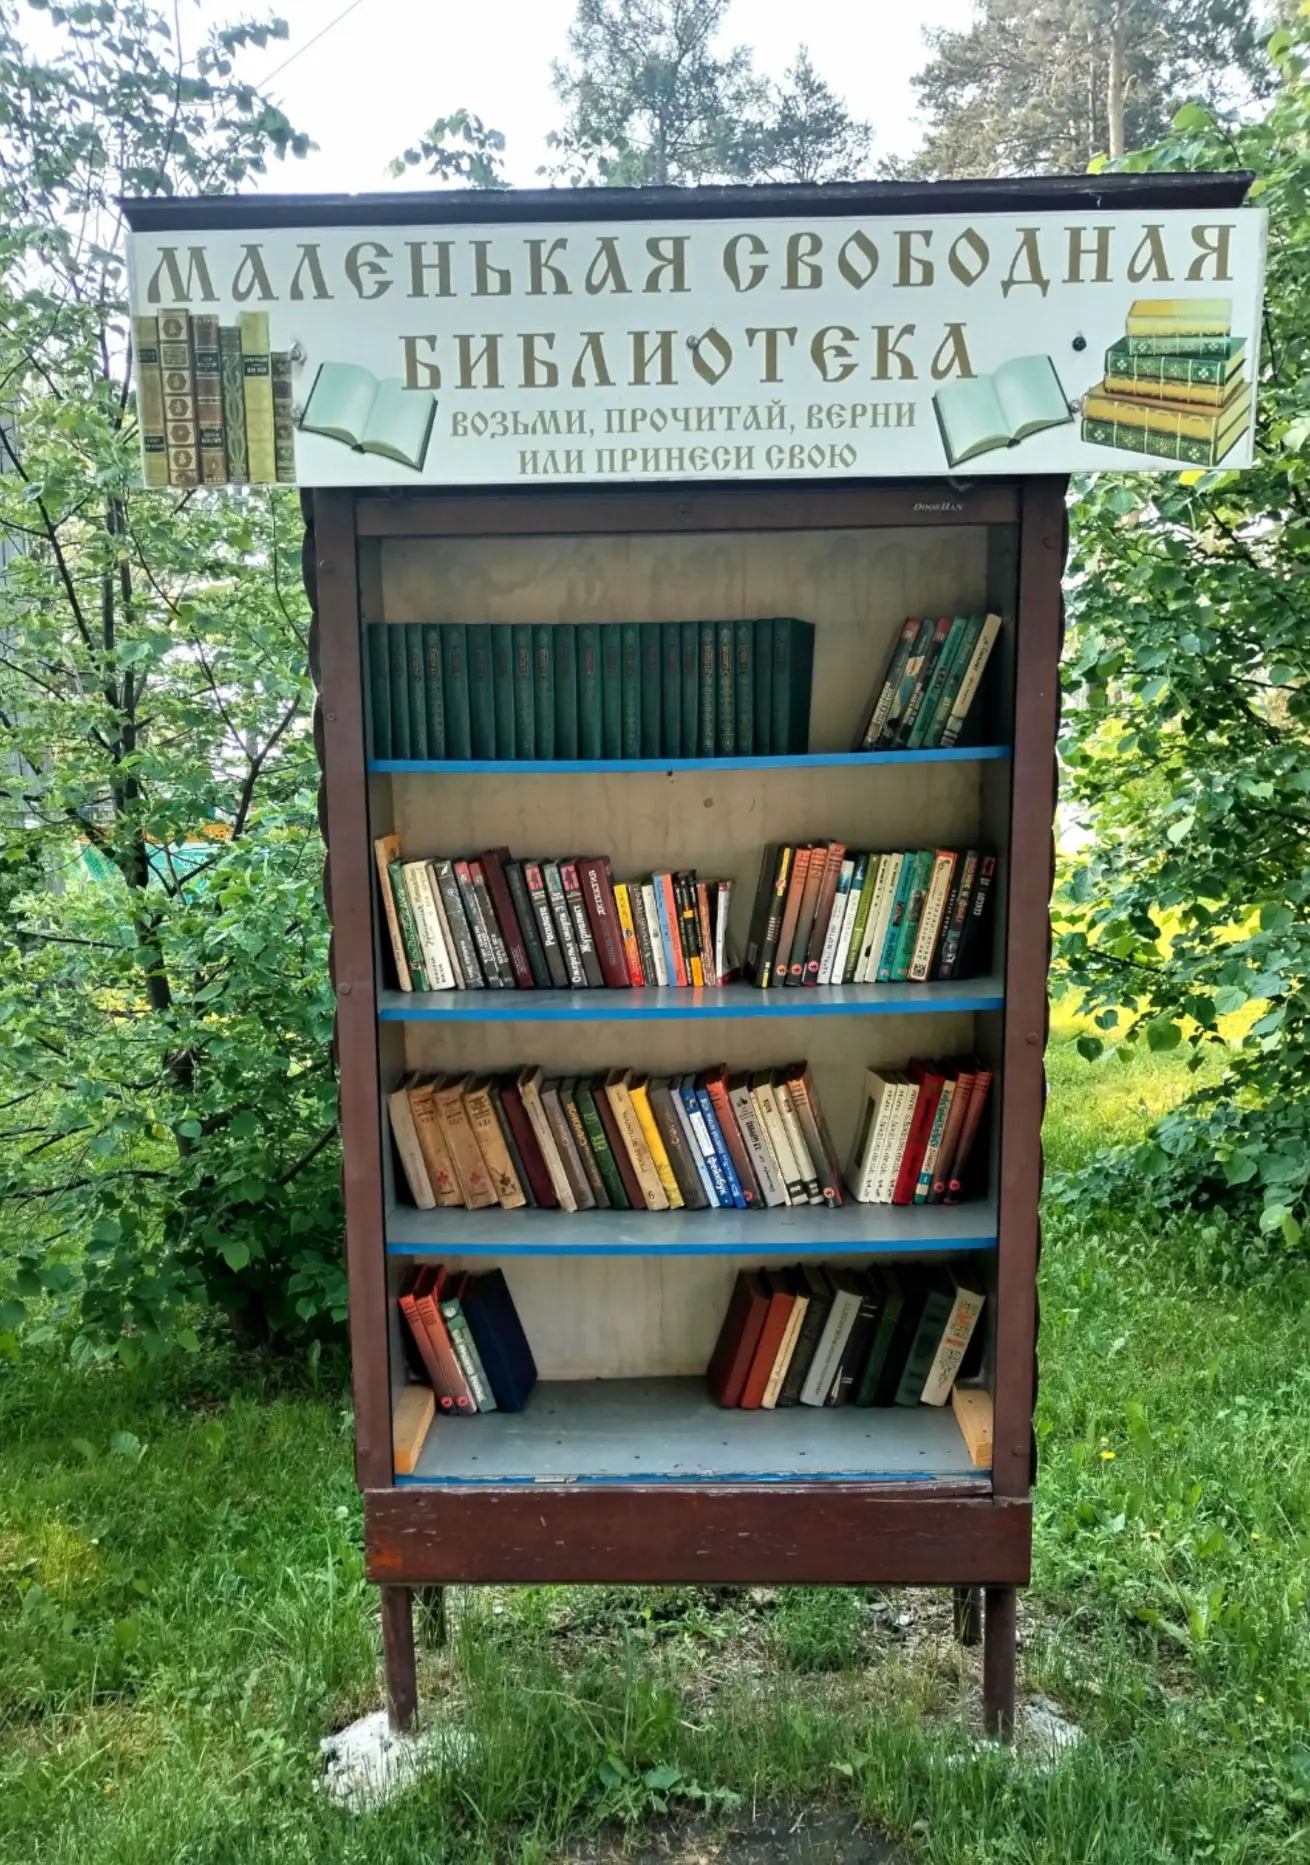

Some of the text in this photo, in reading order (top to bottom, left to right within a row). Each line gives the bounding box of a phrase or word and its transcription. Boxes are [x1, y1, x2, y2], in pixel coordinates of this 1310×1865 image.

[146, 223, 1237, 304] МАЛЕНЬКАЯ СВОБОДНАЯ
[398, 322, 979, 392] БИБЛИОТЕКА
[450, 399, 917, 439] ВОЗЬМИ, ПРОЧИТАЙ, ВЕРНИ
[518, 443, 858, 475] ИЛИ ПРИНЕСИ СВОЮ
